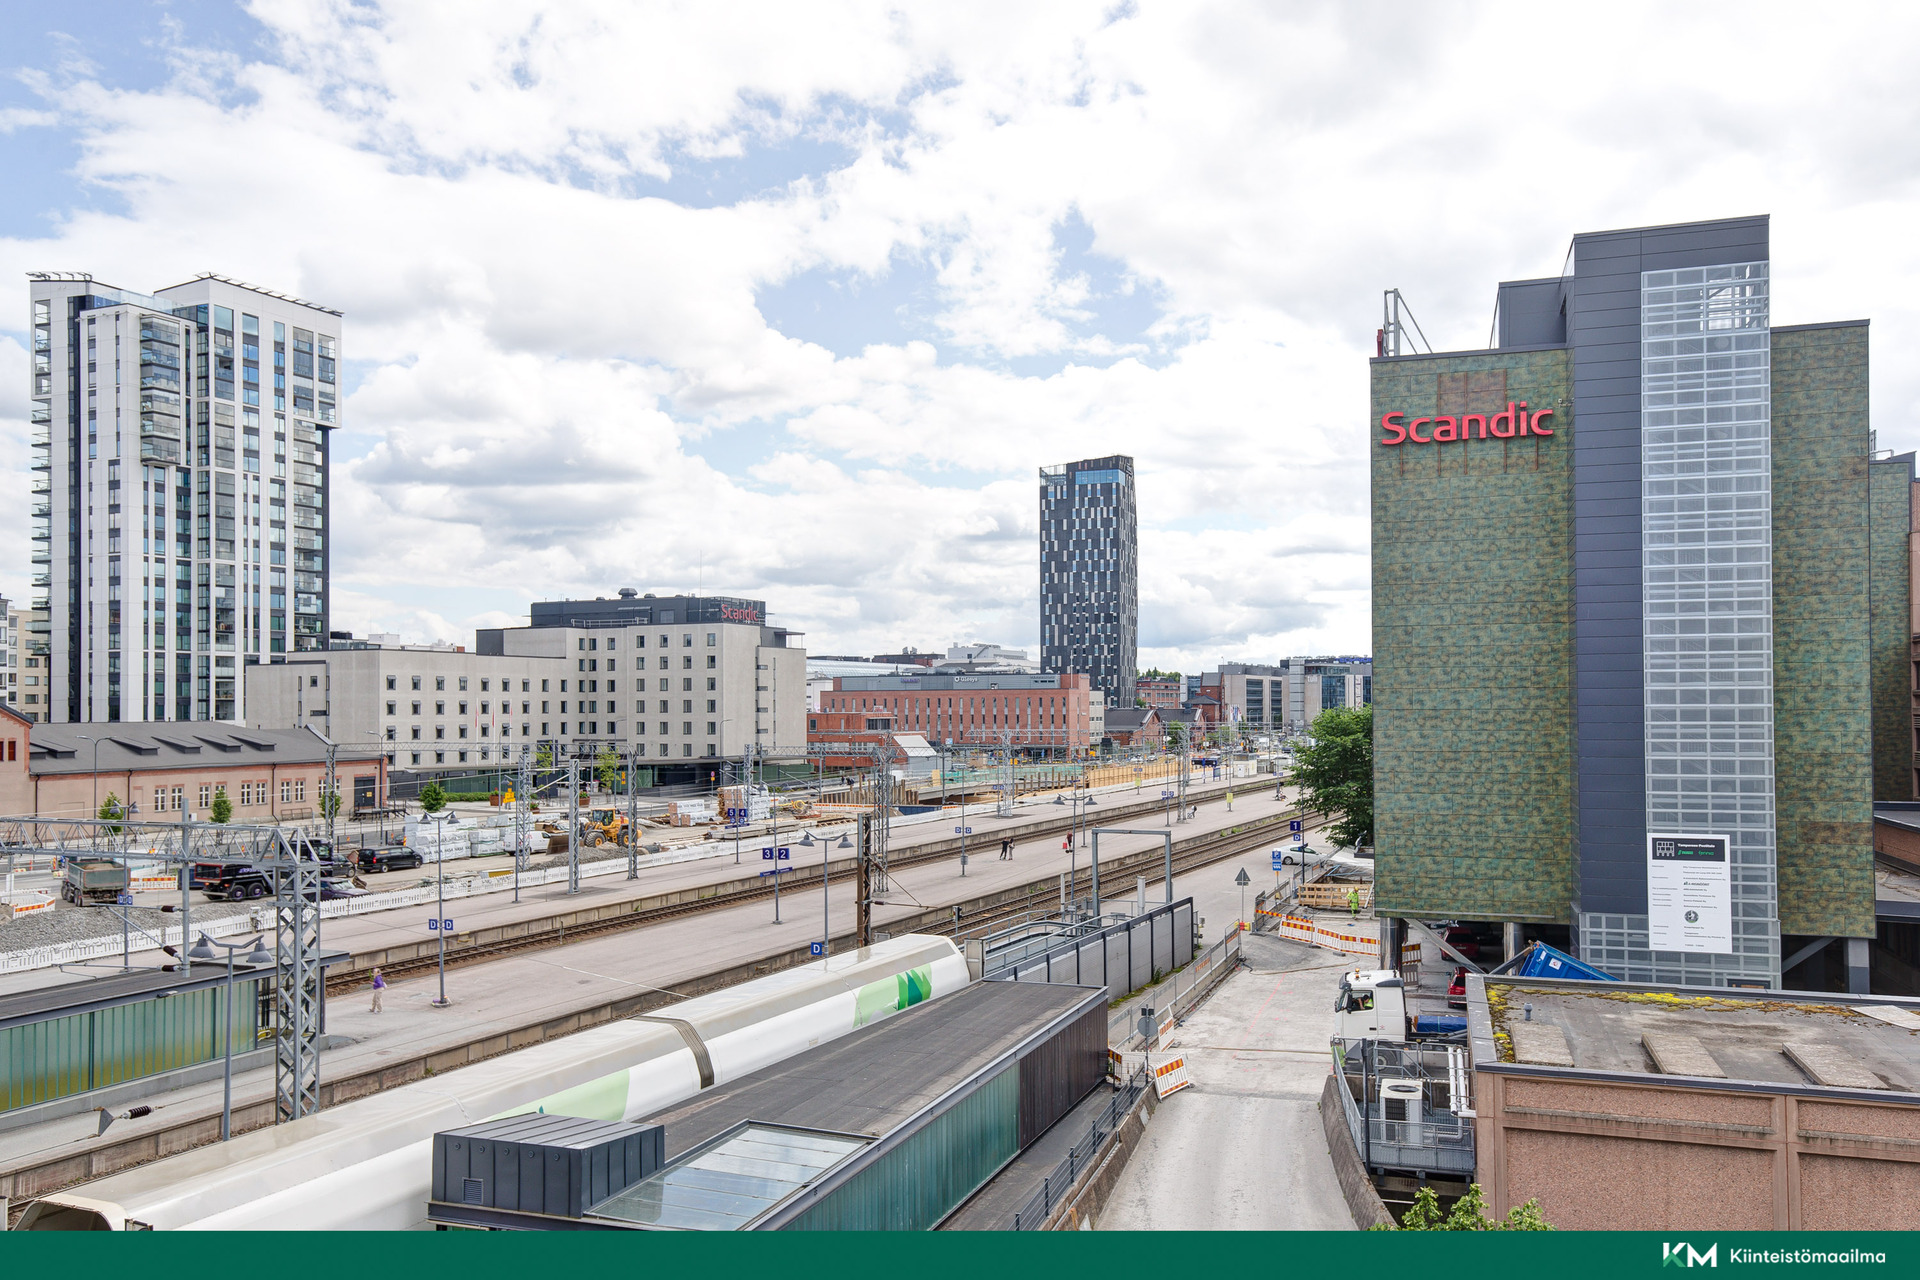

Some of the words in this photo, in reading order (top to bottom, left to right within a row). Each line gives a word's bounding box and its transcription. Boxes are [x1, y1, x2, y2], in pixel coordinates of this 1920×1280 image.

[1381, 401, 1553, 445] Scandic
[721, 604, 759, 621] Scandic
[764, 849, 771, 858] 3
[780, 849, 786, 858] 2
[430, 920, 436, 929] D
[446, 920, 452, 929] D
[813, 944, 820, 953] D
